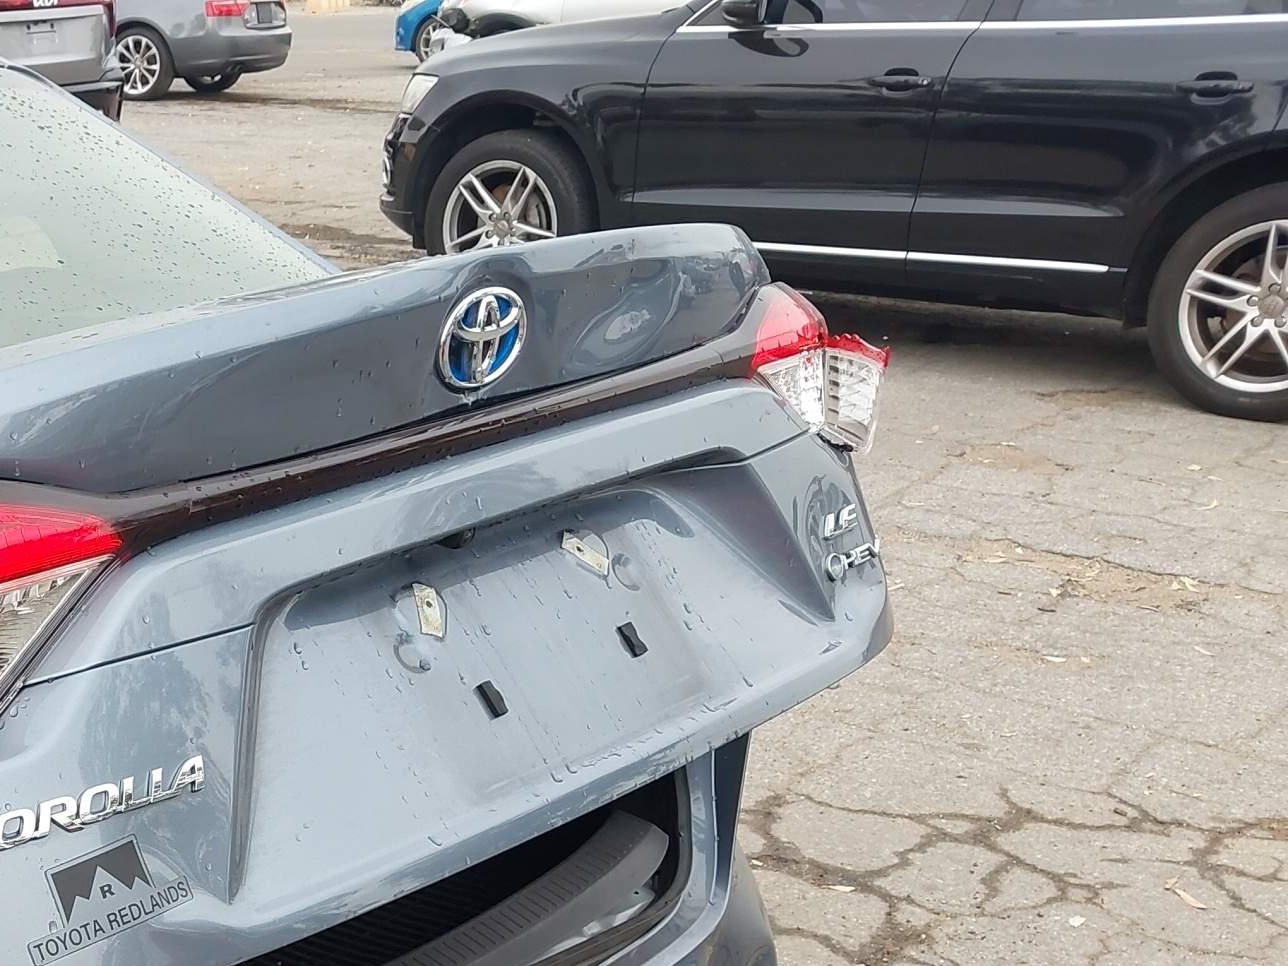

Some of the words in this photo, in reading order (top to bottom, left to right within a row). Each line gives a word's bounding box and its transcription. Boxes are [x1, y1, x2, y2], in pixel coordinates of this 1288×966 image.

[823, 503, 858, 540] LE
[99, 883, 116, 899] R
[33, 919, 106, 963] TOYOTA
[106, 880, 189, 932] REDLANDS
